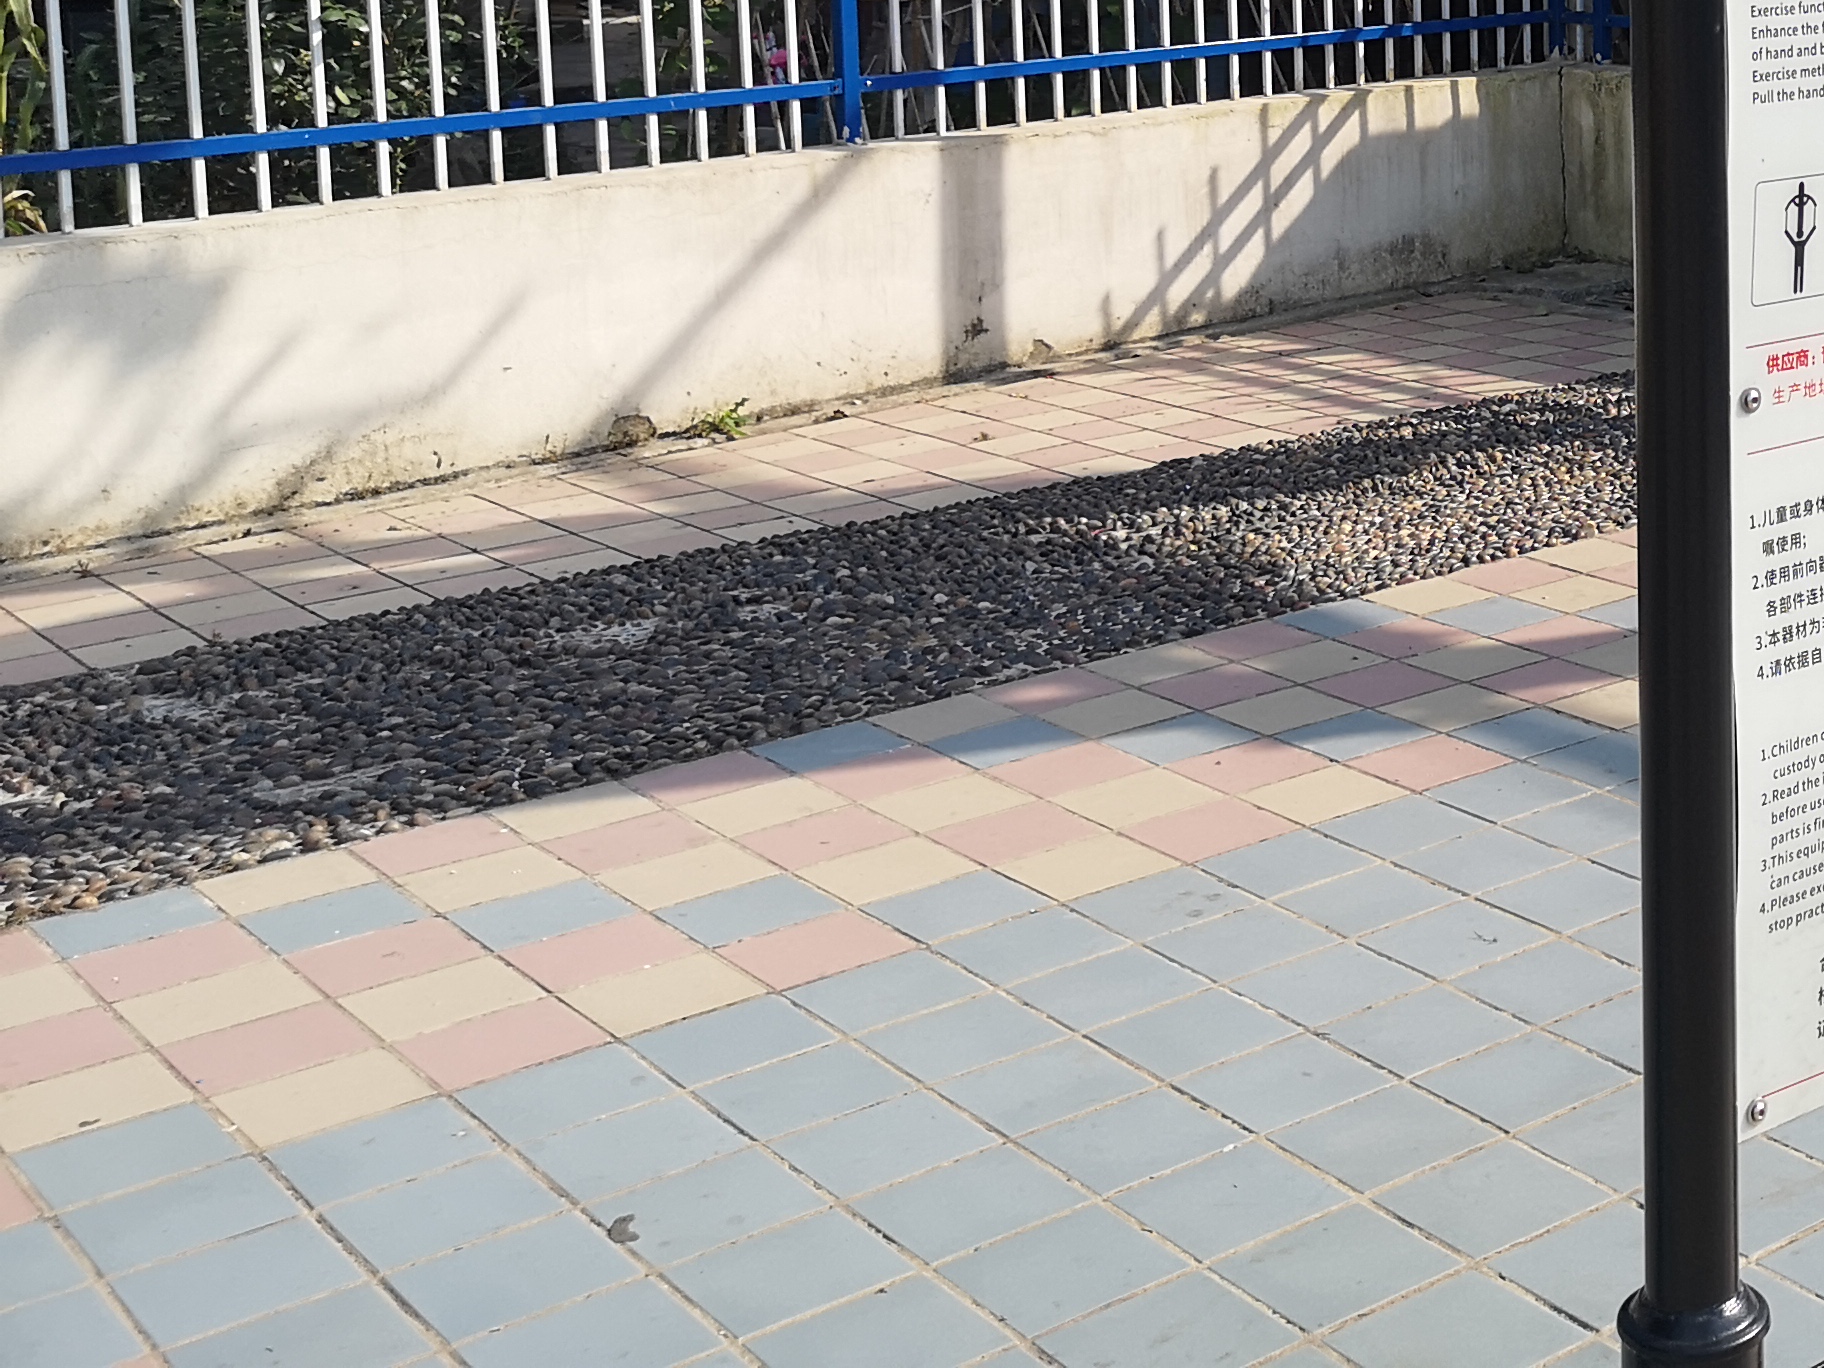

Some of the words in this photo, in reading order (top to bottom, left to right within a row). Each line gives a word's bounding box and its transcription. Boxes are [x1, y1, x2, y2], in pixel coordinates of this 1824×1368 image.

[1750, 2, 1796, 18] Exercise
[1751, 25, 1798, 40] Enhance
[1801, 22, 1819, 36] the
[1752, 47, 1763, 62] of
[1766, 44, 1794, 61] hand
[1796, 42, 1817, 58] and
[1752, 67, 1798, 83] Exercise
[1752, 89, 1774, 105] Pull
[1777, 88, 1796, 102] the
[1773, 755, 1816, 780] custody
[1802, 776, 1820, 792] the
[1771, 804, 1808, 825] before
[1771, 827, 1800, 850] parts
[1802, 822, 1812, 836] is
[1770, 876, 1790, 891] can
[1792, 862, 1824, 882] cause
[1768, 916, 1793, 934] stop
